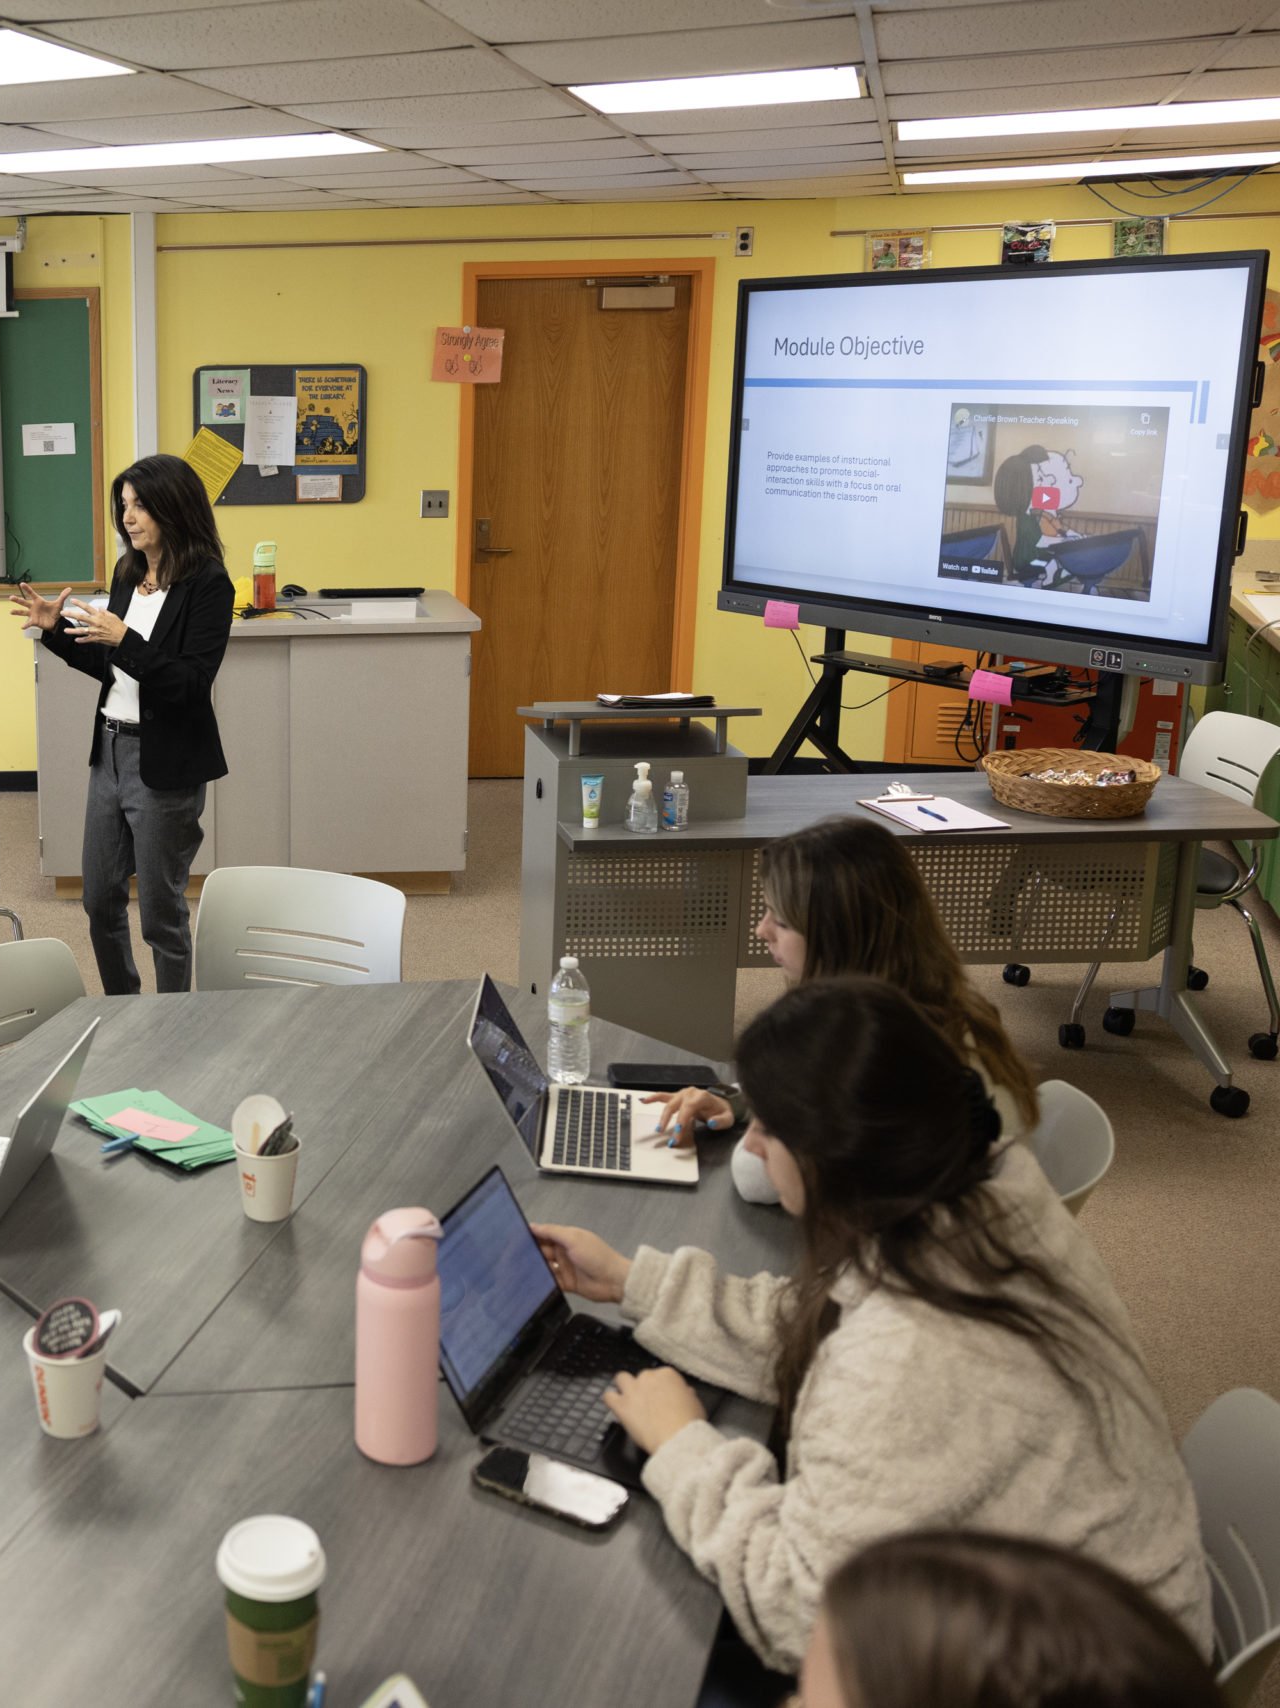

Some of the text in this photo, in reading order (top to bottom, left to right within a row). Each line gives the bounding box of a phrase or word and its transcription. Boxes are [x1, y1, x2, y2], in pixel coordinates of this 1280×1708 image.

[441, 332, 499, 350] Strongly Agree
[774, 335, 925, 360] Module Objective
[973, 414, 1079, 426] Charlie Brown Teacher Speaking
[767, 451, 891, 466] Provide examples of instructional
[766, 464, 880, 478] approaches to promote social-
[765, 475, 902, 493] interaction skills with a focus on oral
[764, 487, 878, 503] communication the classroom
[942, 562, 960, 571] Watch
